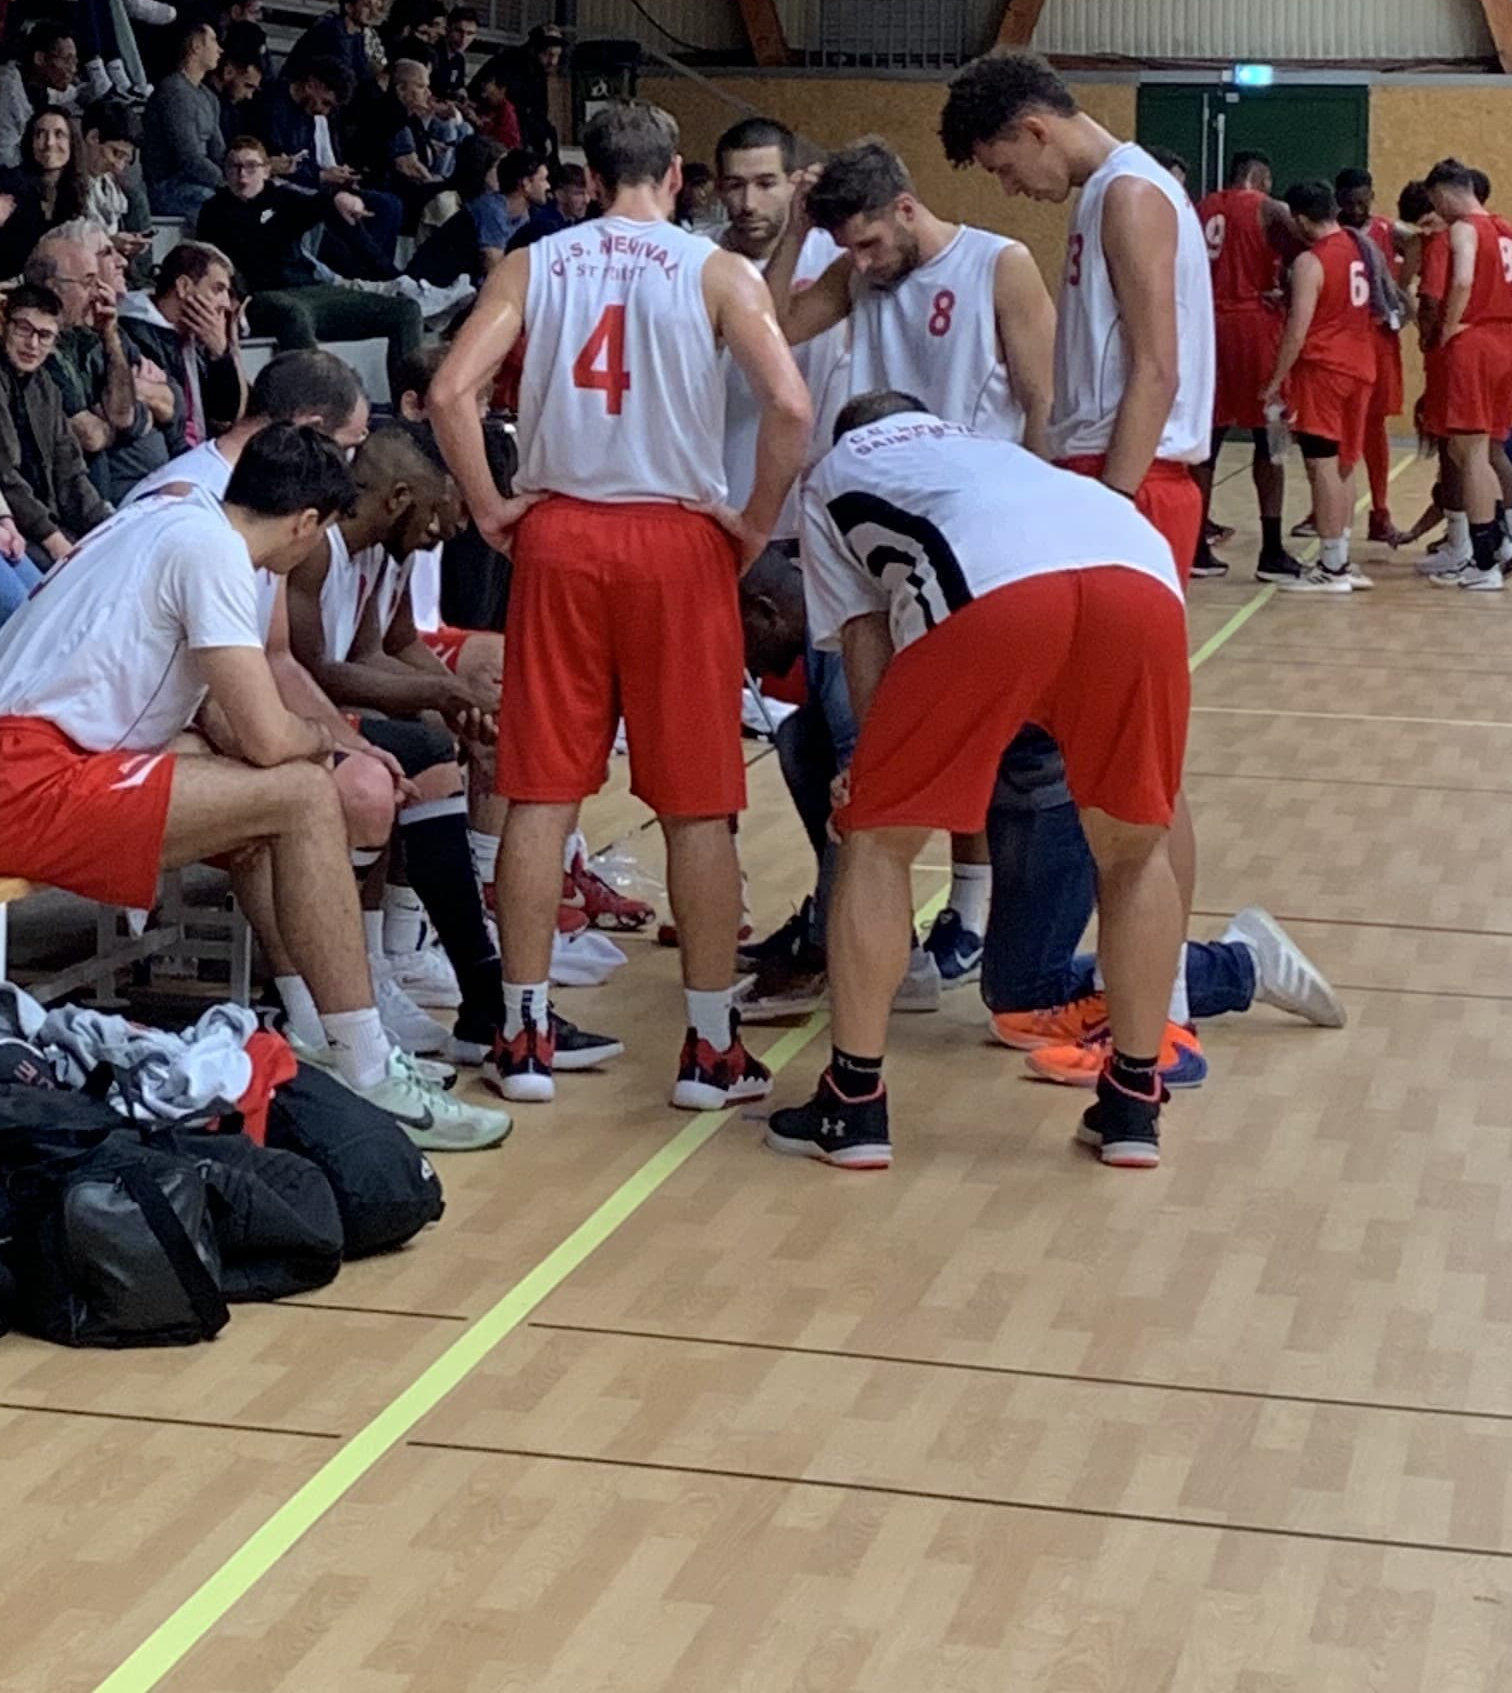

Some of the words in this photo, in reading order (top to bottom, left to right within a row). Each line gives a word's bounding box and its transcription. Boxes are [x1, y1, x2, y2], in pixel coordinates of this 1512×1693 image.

[1349, 260, 1370, 307] 6
[928, 289, 955, 337] 8
[573, 304, 630, 415] 4
